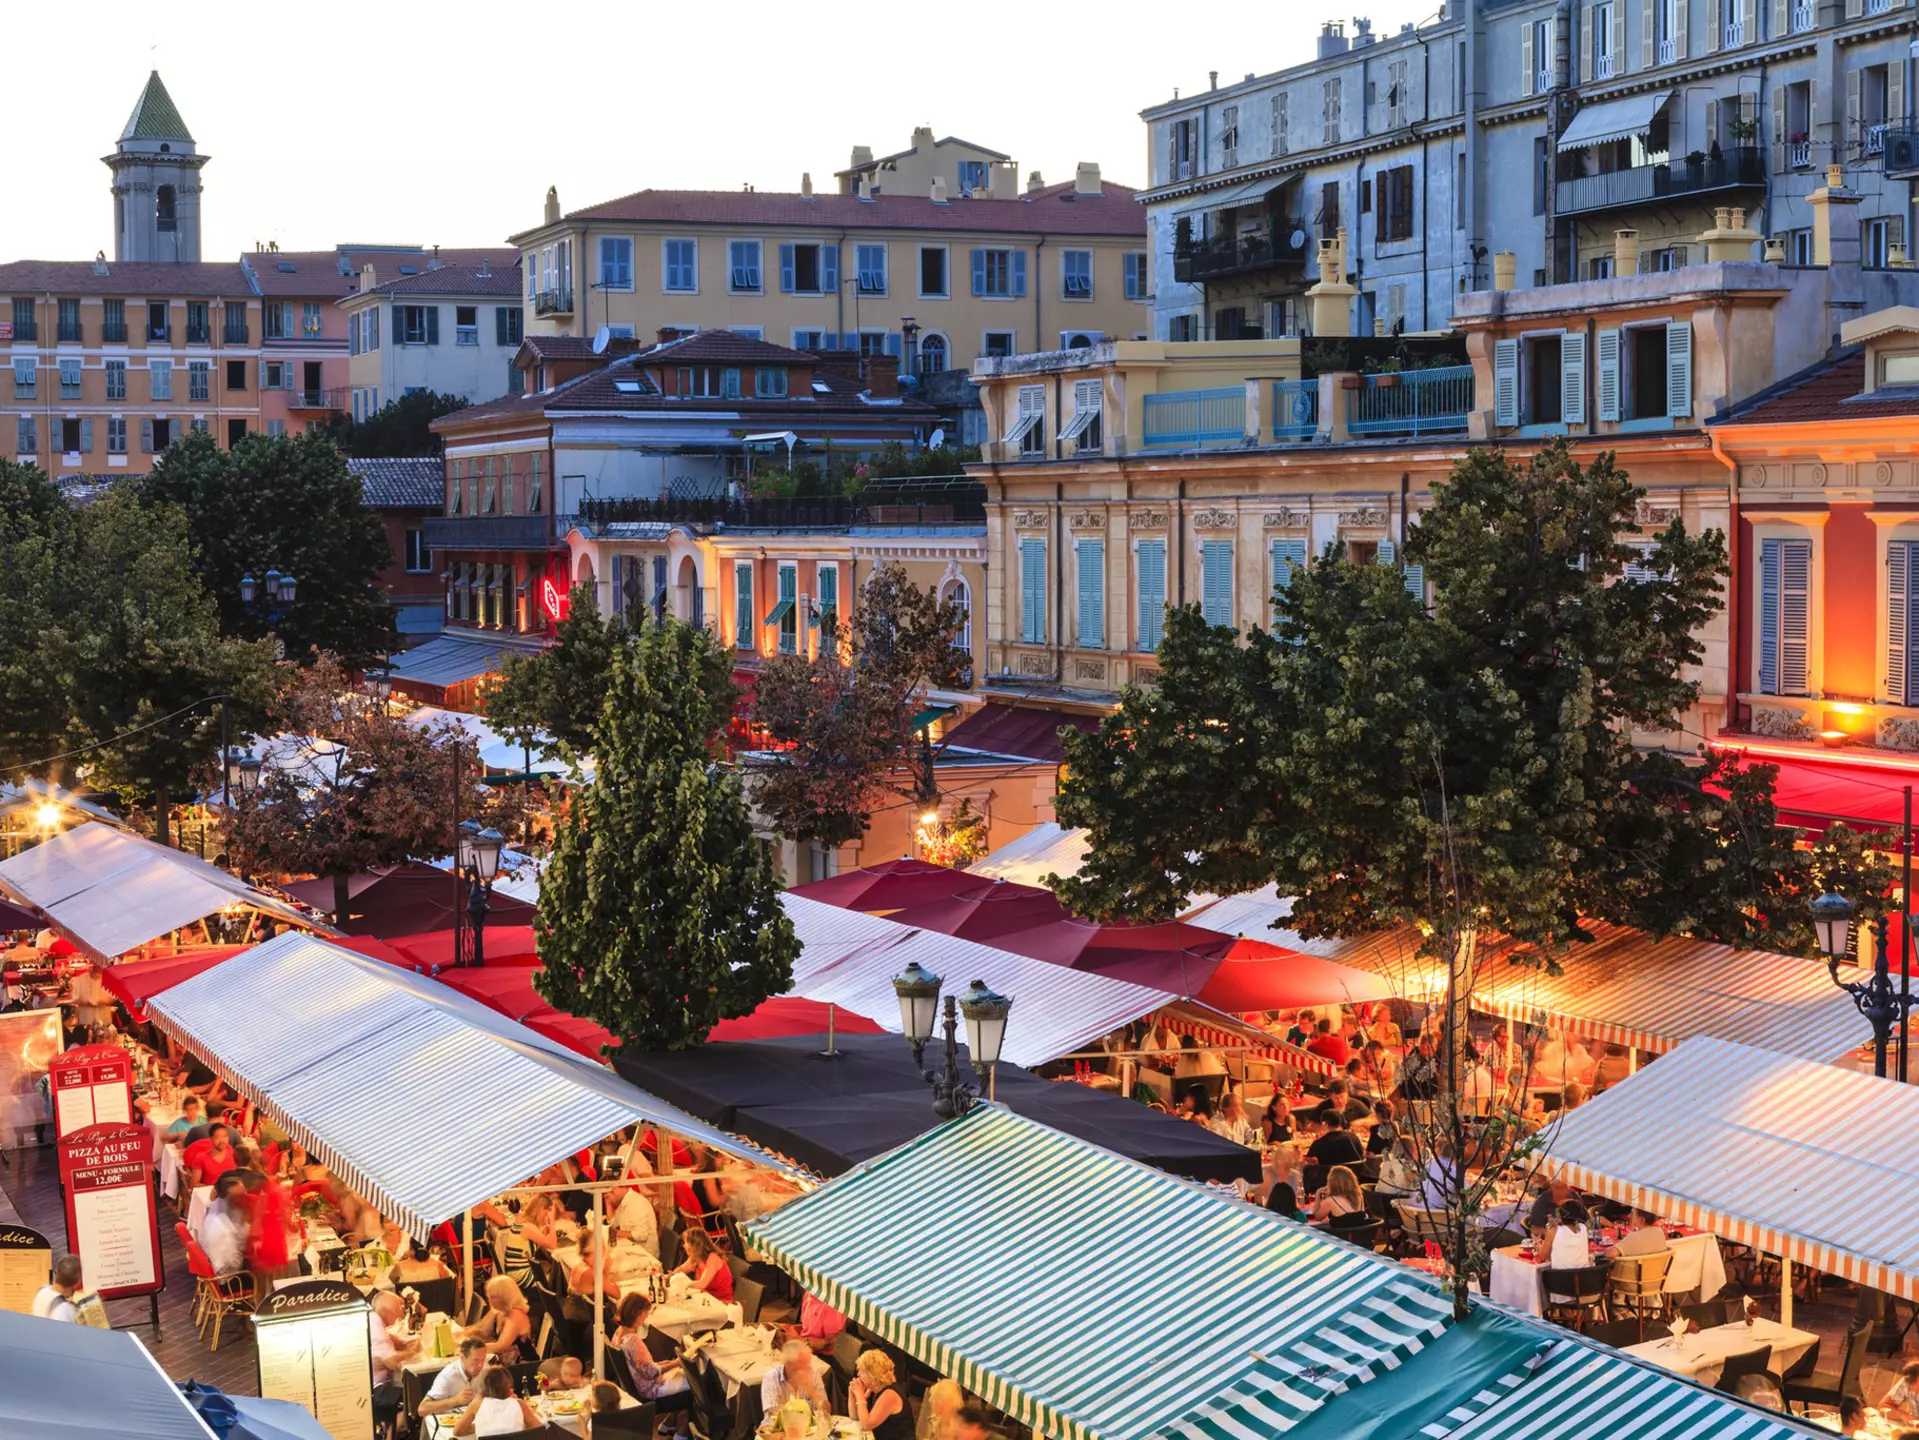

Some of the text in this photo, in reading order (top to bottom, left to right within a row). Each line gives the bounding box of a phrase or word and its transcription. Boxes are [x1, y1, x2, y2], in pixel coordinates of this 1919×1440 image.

[68, 1140, 142, 1159] PIZZA AU FEU
[86, 1152, 129, 1166] DE BOIS
[75, 1169, 98, 1180] MENU
[103, 1164, 141, 1176] FORMULE
[95, 1174, 123, 1186] 12,00€
[270, 1287, 350, 1314] Paradice
